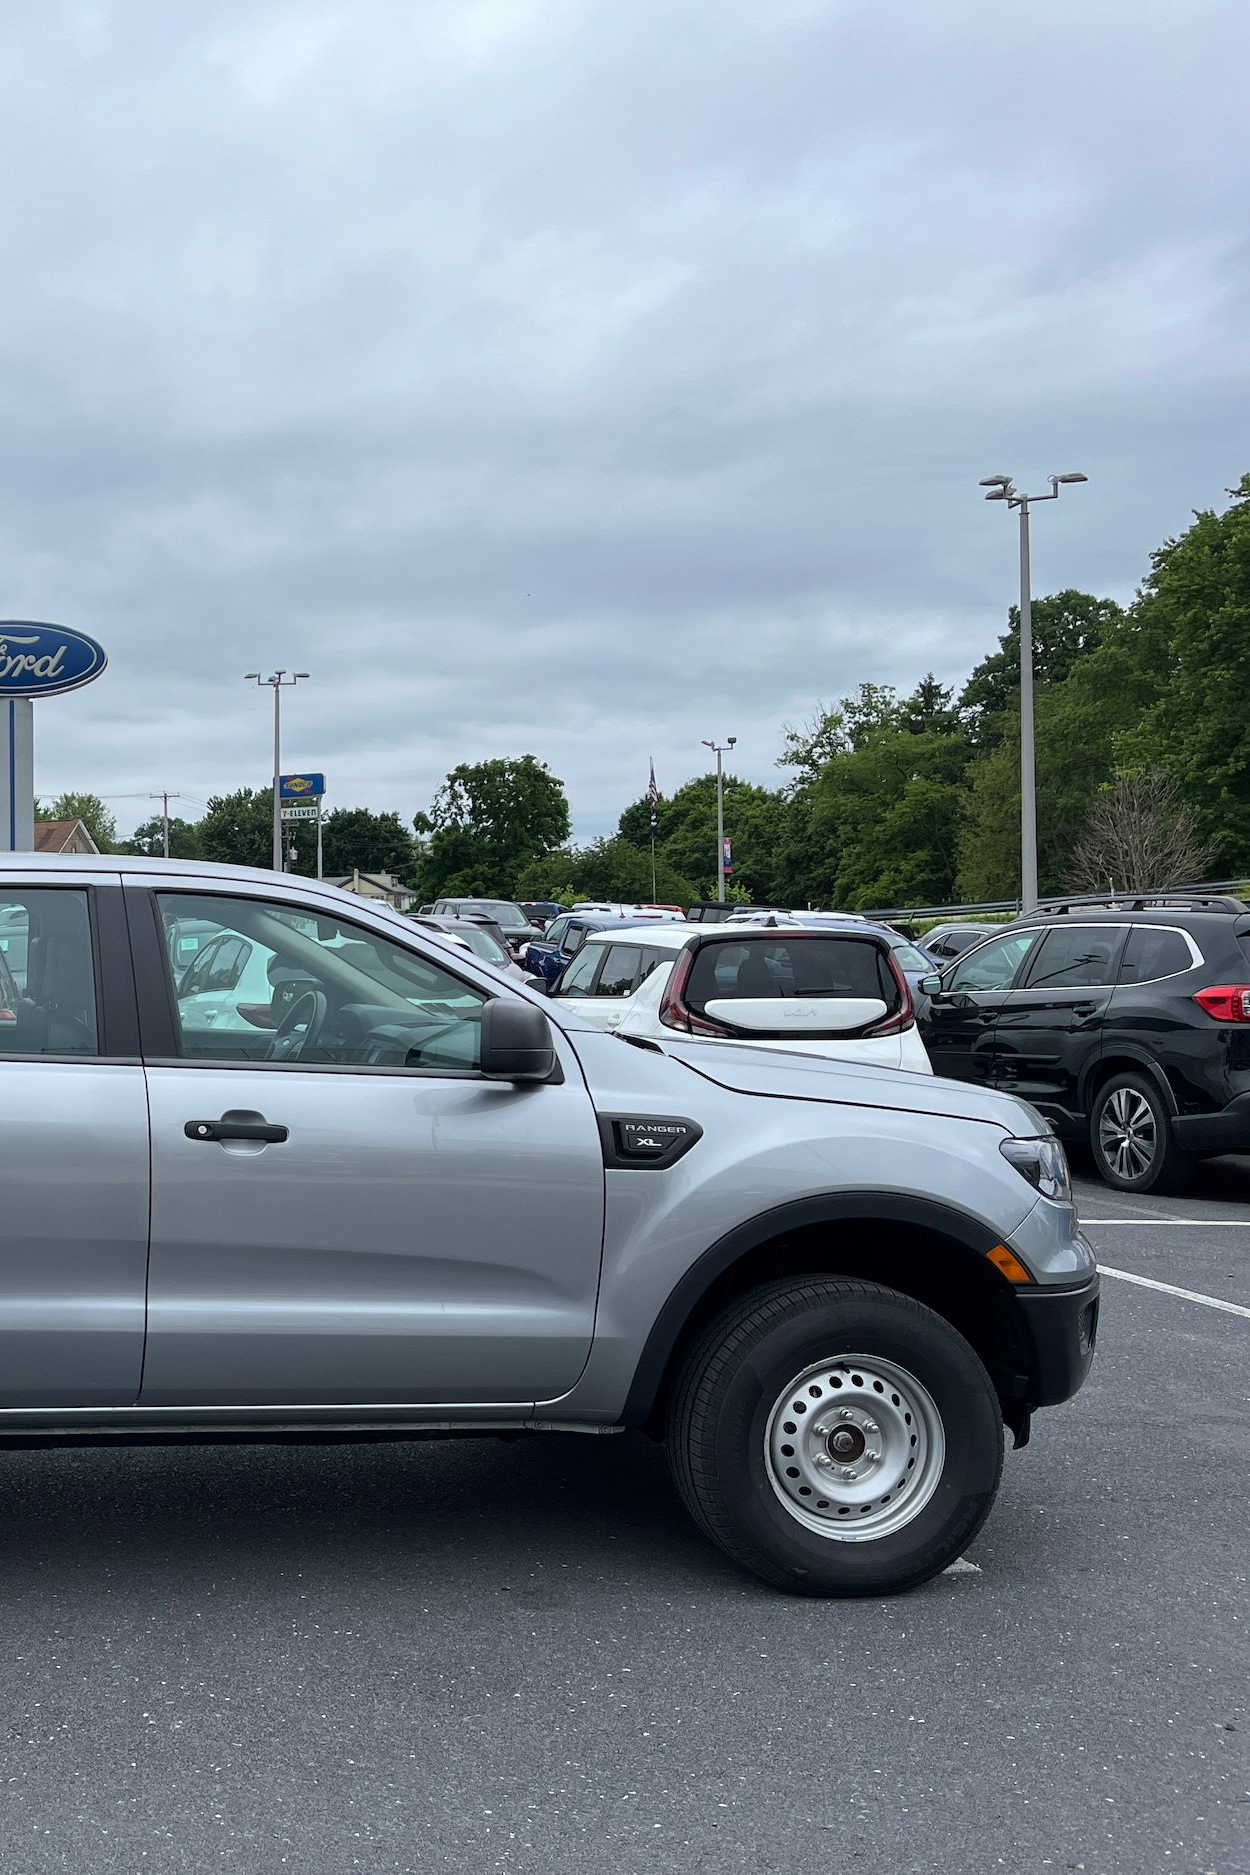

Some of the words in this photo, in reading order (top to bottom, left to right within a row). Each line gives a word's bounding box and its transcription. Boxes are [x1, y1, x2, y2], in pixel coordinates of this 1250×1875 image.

[285, 780, 312, 789] SUNOCO
[626, 1123, 688, 1134] RANGER
[637, 1138, 662, 1147] XL
